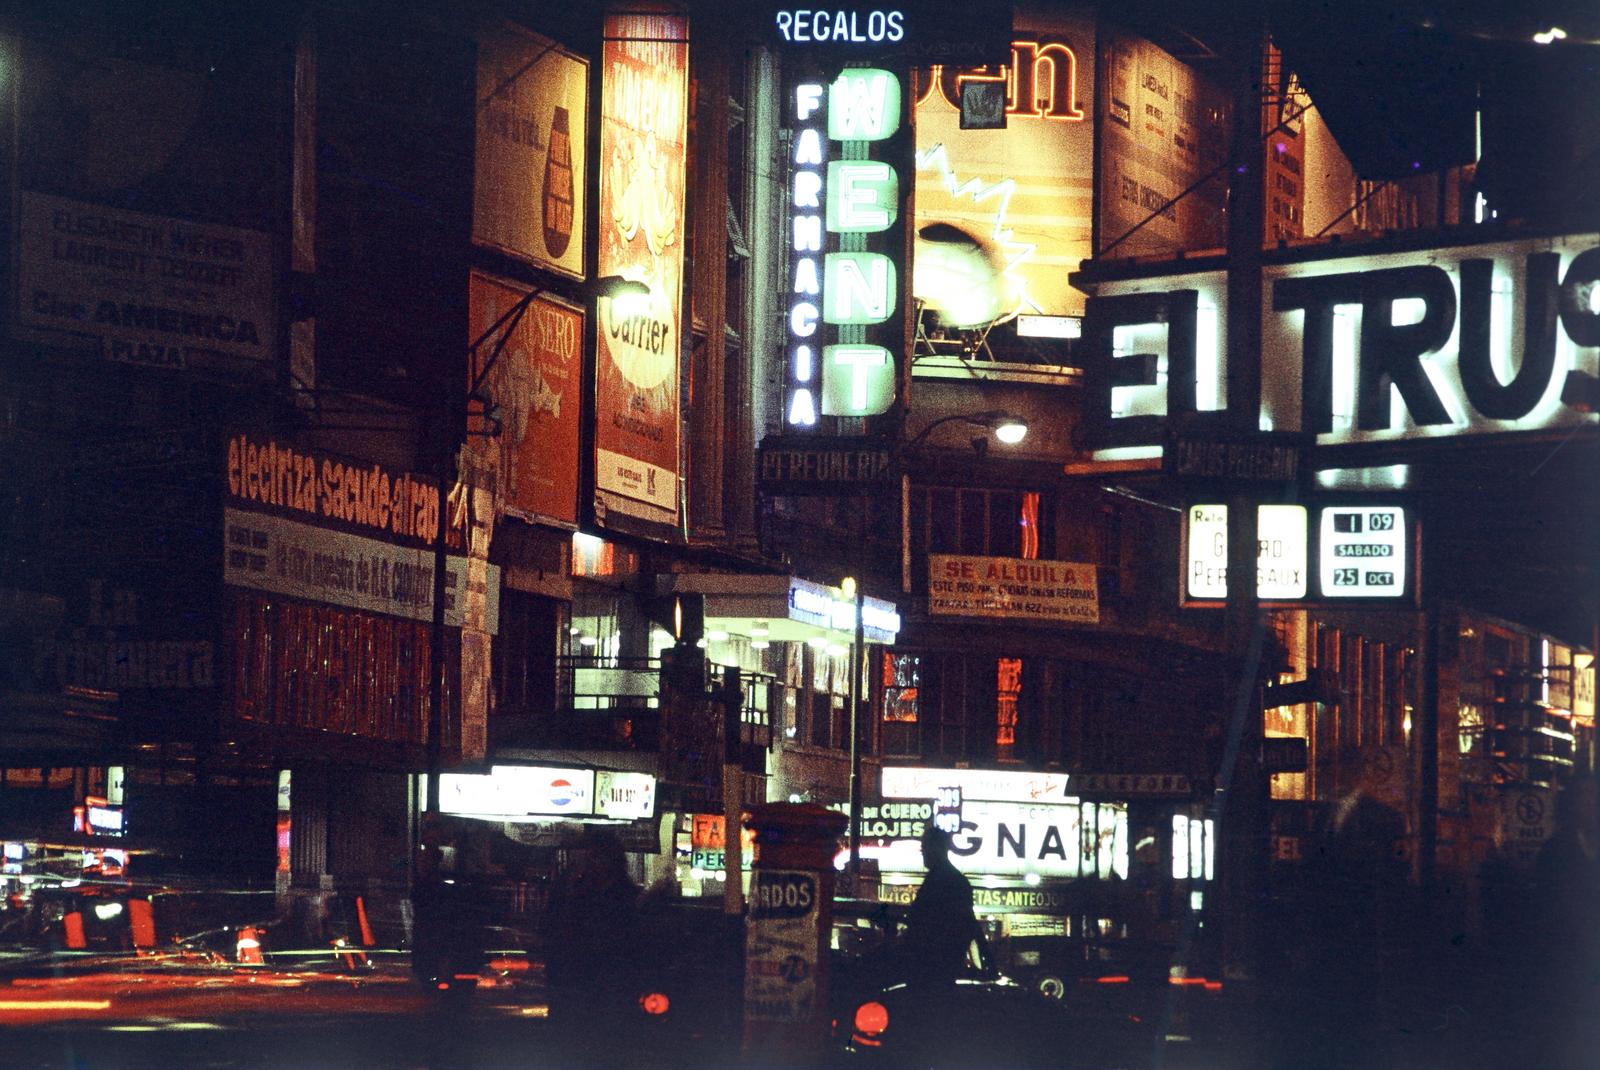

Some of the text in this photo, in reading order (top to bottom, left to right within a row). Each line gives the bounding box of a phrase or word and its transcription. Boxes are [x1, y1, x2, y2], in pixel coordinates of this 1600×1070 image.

[776, 10, 904, 42] REGALOS
[834, 74, 890, 412] WENT
[788, 83, 823, 427] FARMACIA
[93, 301, 261, 345] AMERICA
[608, 305, 669, 356] Carrier
[1086, 289, 1229, 450] EL
[1194, 509, 1225, 523] Relo
[1370, 515, 1392, 531] 09
[1339, 545, 1391, 557] SABADO
[946, 561, 1077, 584] SE ALQUILA
[1194, 560, 1300, 585] PERGAUX
[1335, 569, 1392, 585] 25 OCT
[933, 580, 953, 592] ESTE
[880, 803, 932, 820] CUERO
[844, 821, 926, 837] LOJES
